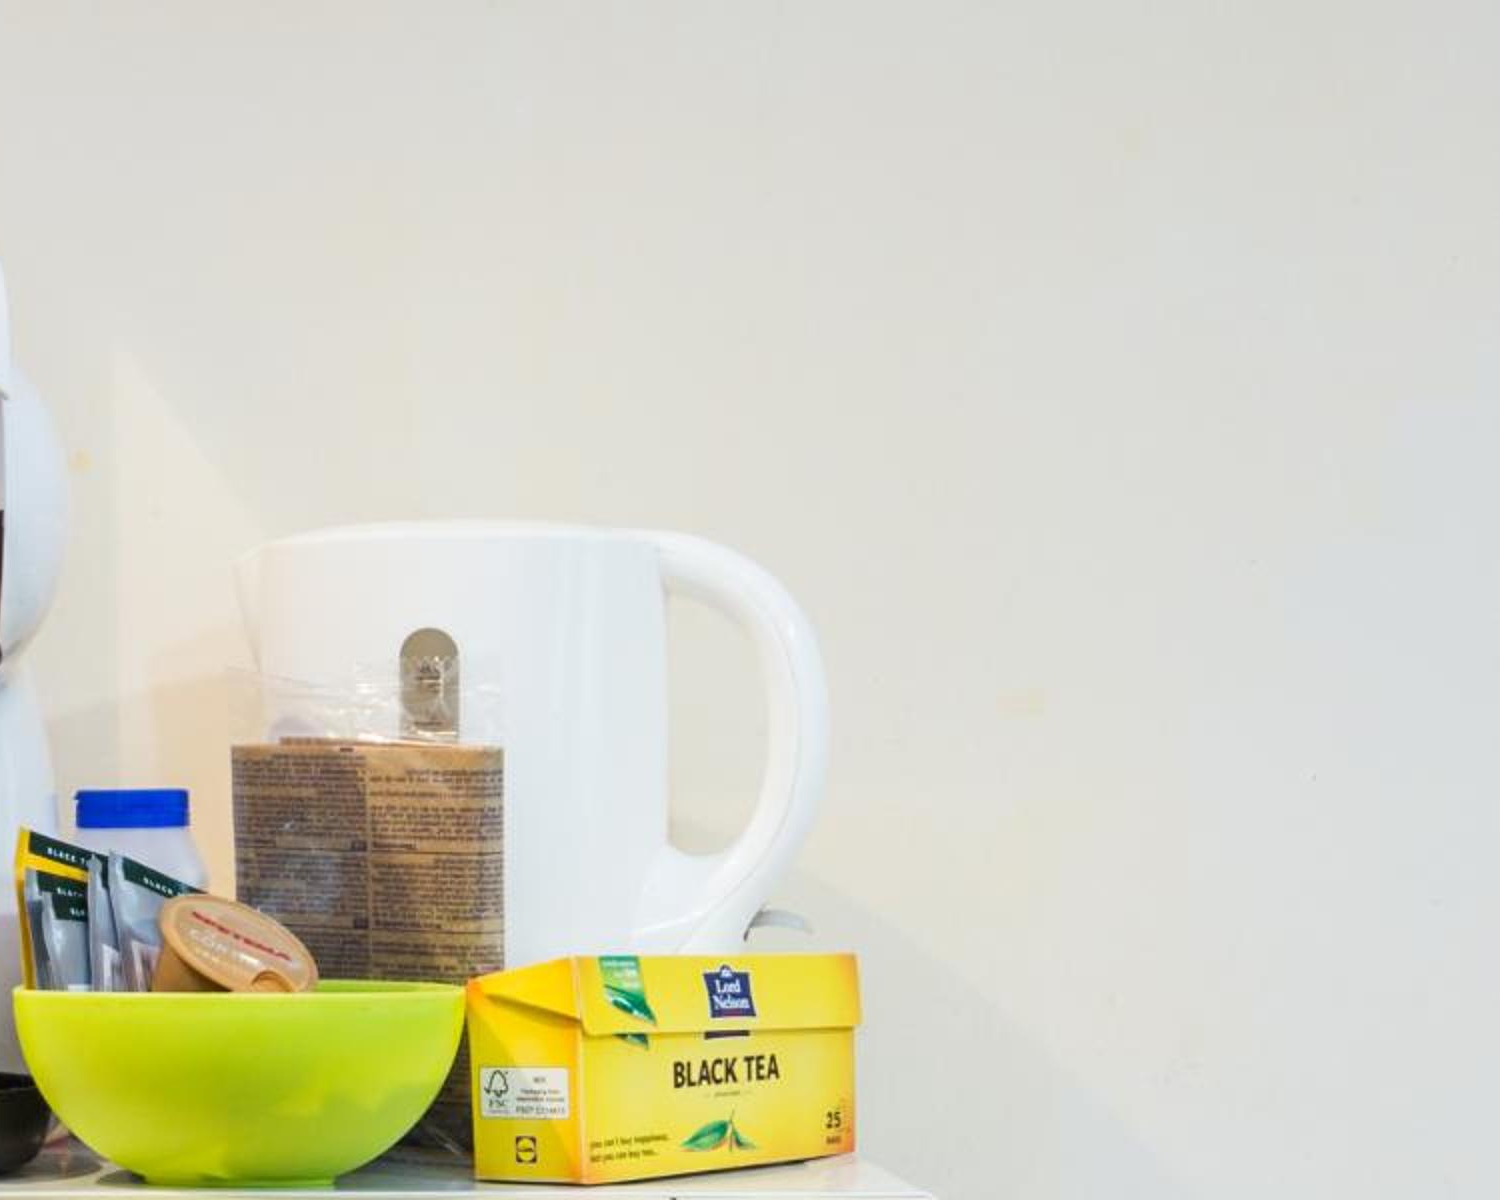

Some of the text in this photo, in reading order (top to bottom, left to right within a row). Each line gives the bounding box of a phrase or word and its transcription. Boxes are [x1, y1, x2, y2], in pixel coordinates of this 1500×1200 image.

[715, 979, 742, 994] Lord
[712, 995, 751, 1010] Nelson
[672, 1053, 781, 1088] BLACK TEA
[825, 1111, 842, 1129] 25
